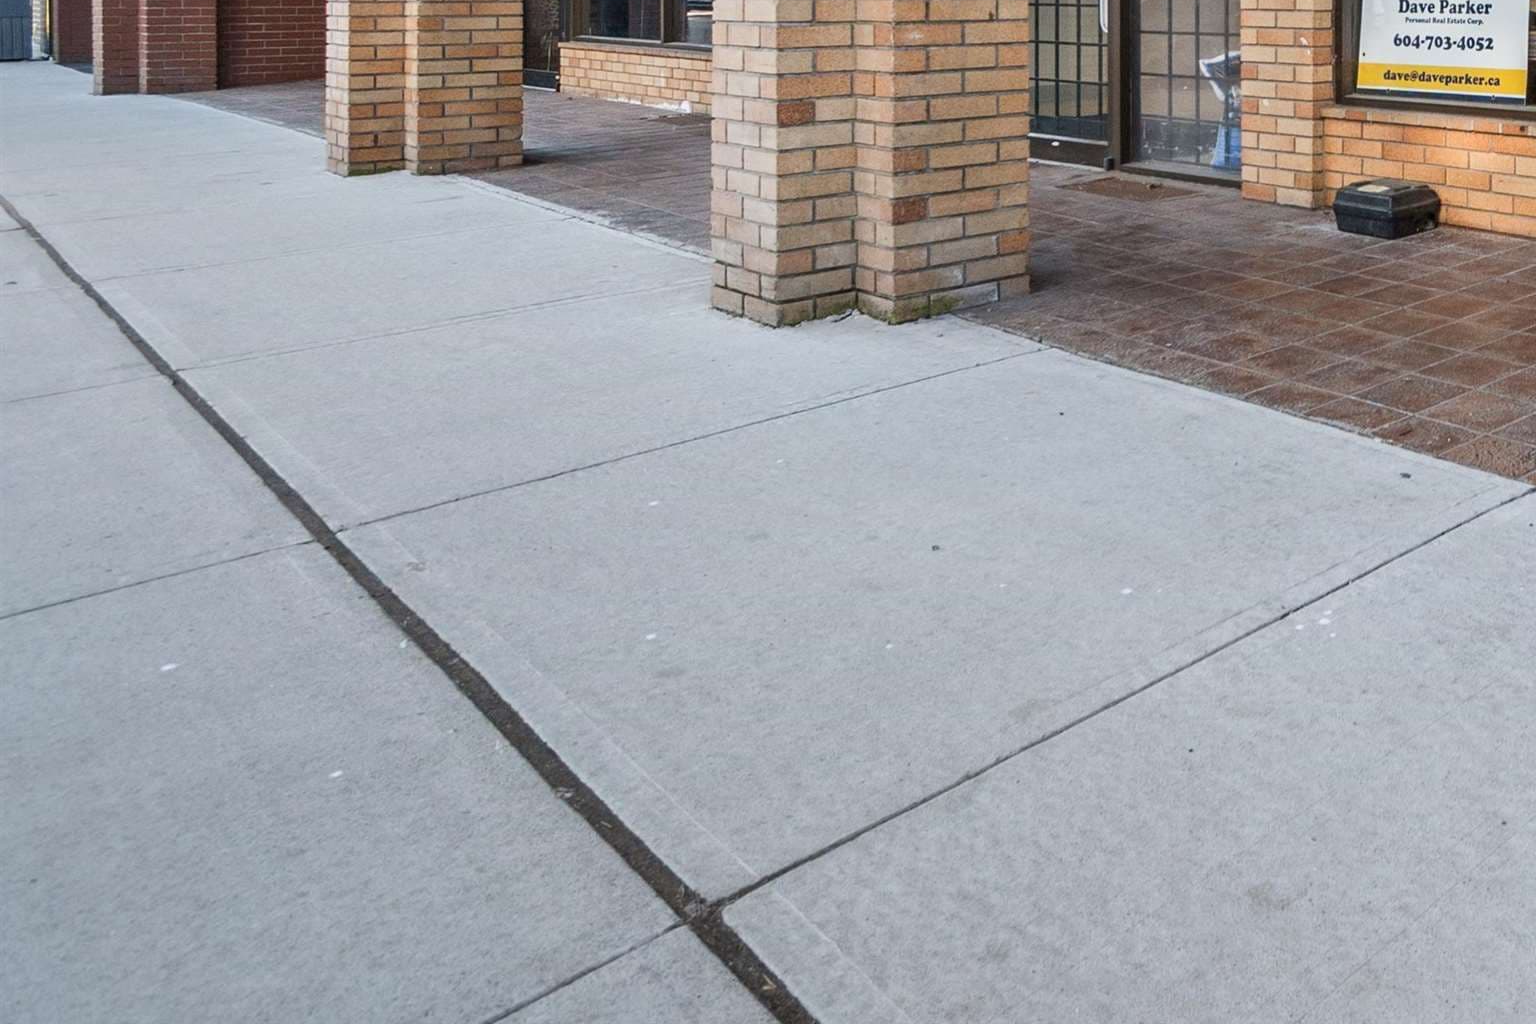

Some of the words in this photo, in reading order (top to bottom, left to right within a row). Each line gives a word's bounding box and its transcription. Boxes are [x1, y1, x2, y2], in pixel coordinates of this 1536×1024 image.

[1398, 0, 1435, 14] Dave
[1439, 0, 1492, 15] Parker
[1467, 18, 1484, 26] Corp.
[1393, 33, 1494, 51] 604-703-4052
[1383, 70, 1501, 87] dave@daveparker.ca
